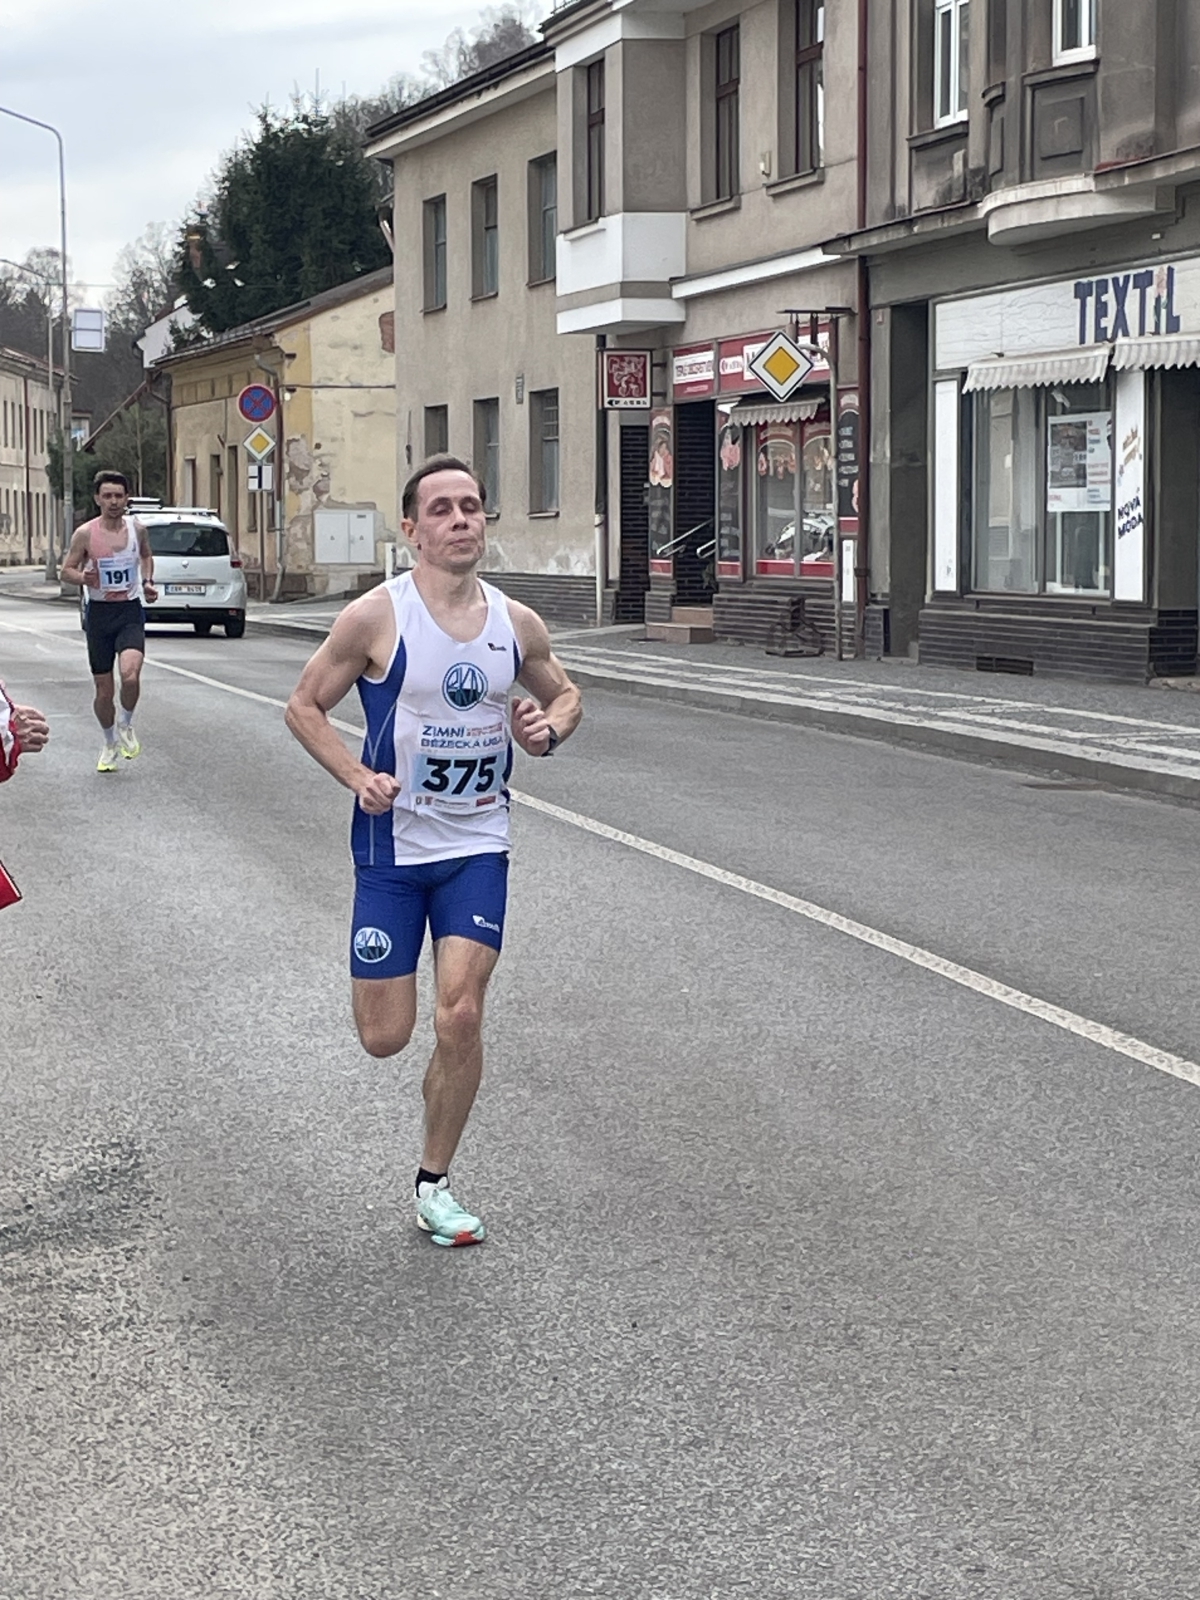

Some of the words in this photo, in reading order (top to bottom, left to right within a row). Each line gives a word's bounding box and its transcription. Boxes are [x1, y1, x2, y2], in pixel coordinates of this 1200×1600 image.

[1074, 265, 1180, 345] TEXTIL
[105, 569, 129, 585] 191
[421, 755, 497, 795] 375
